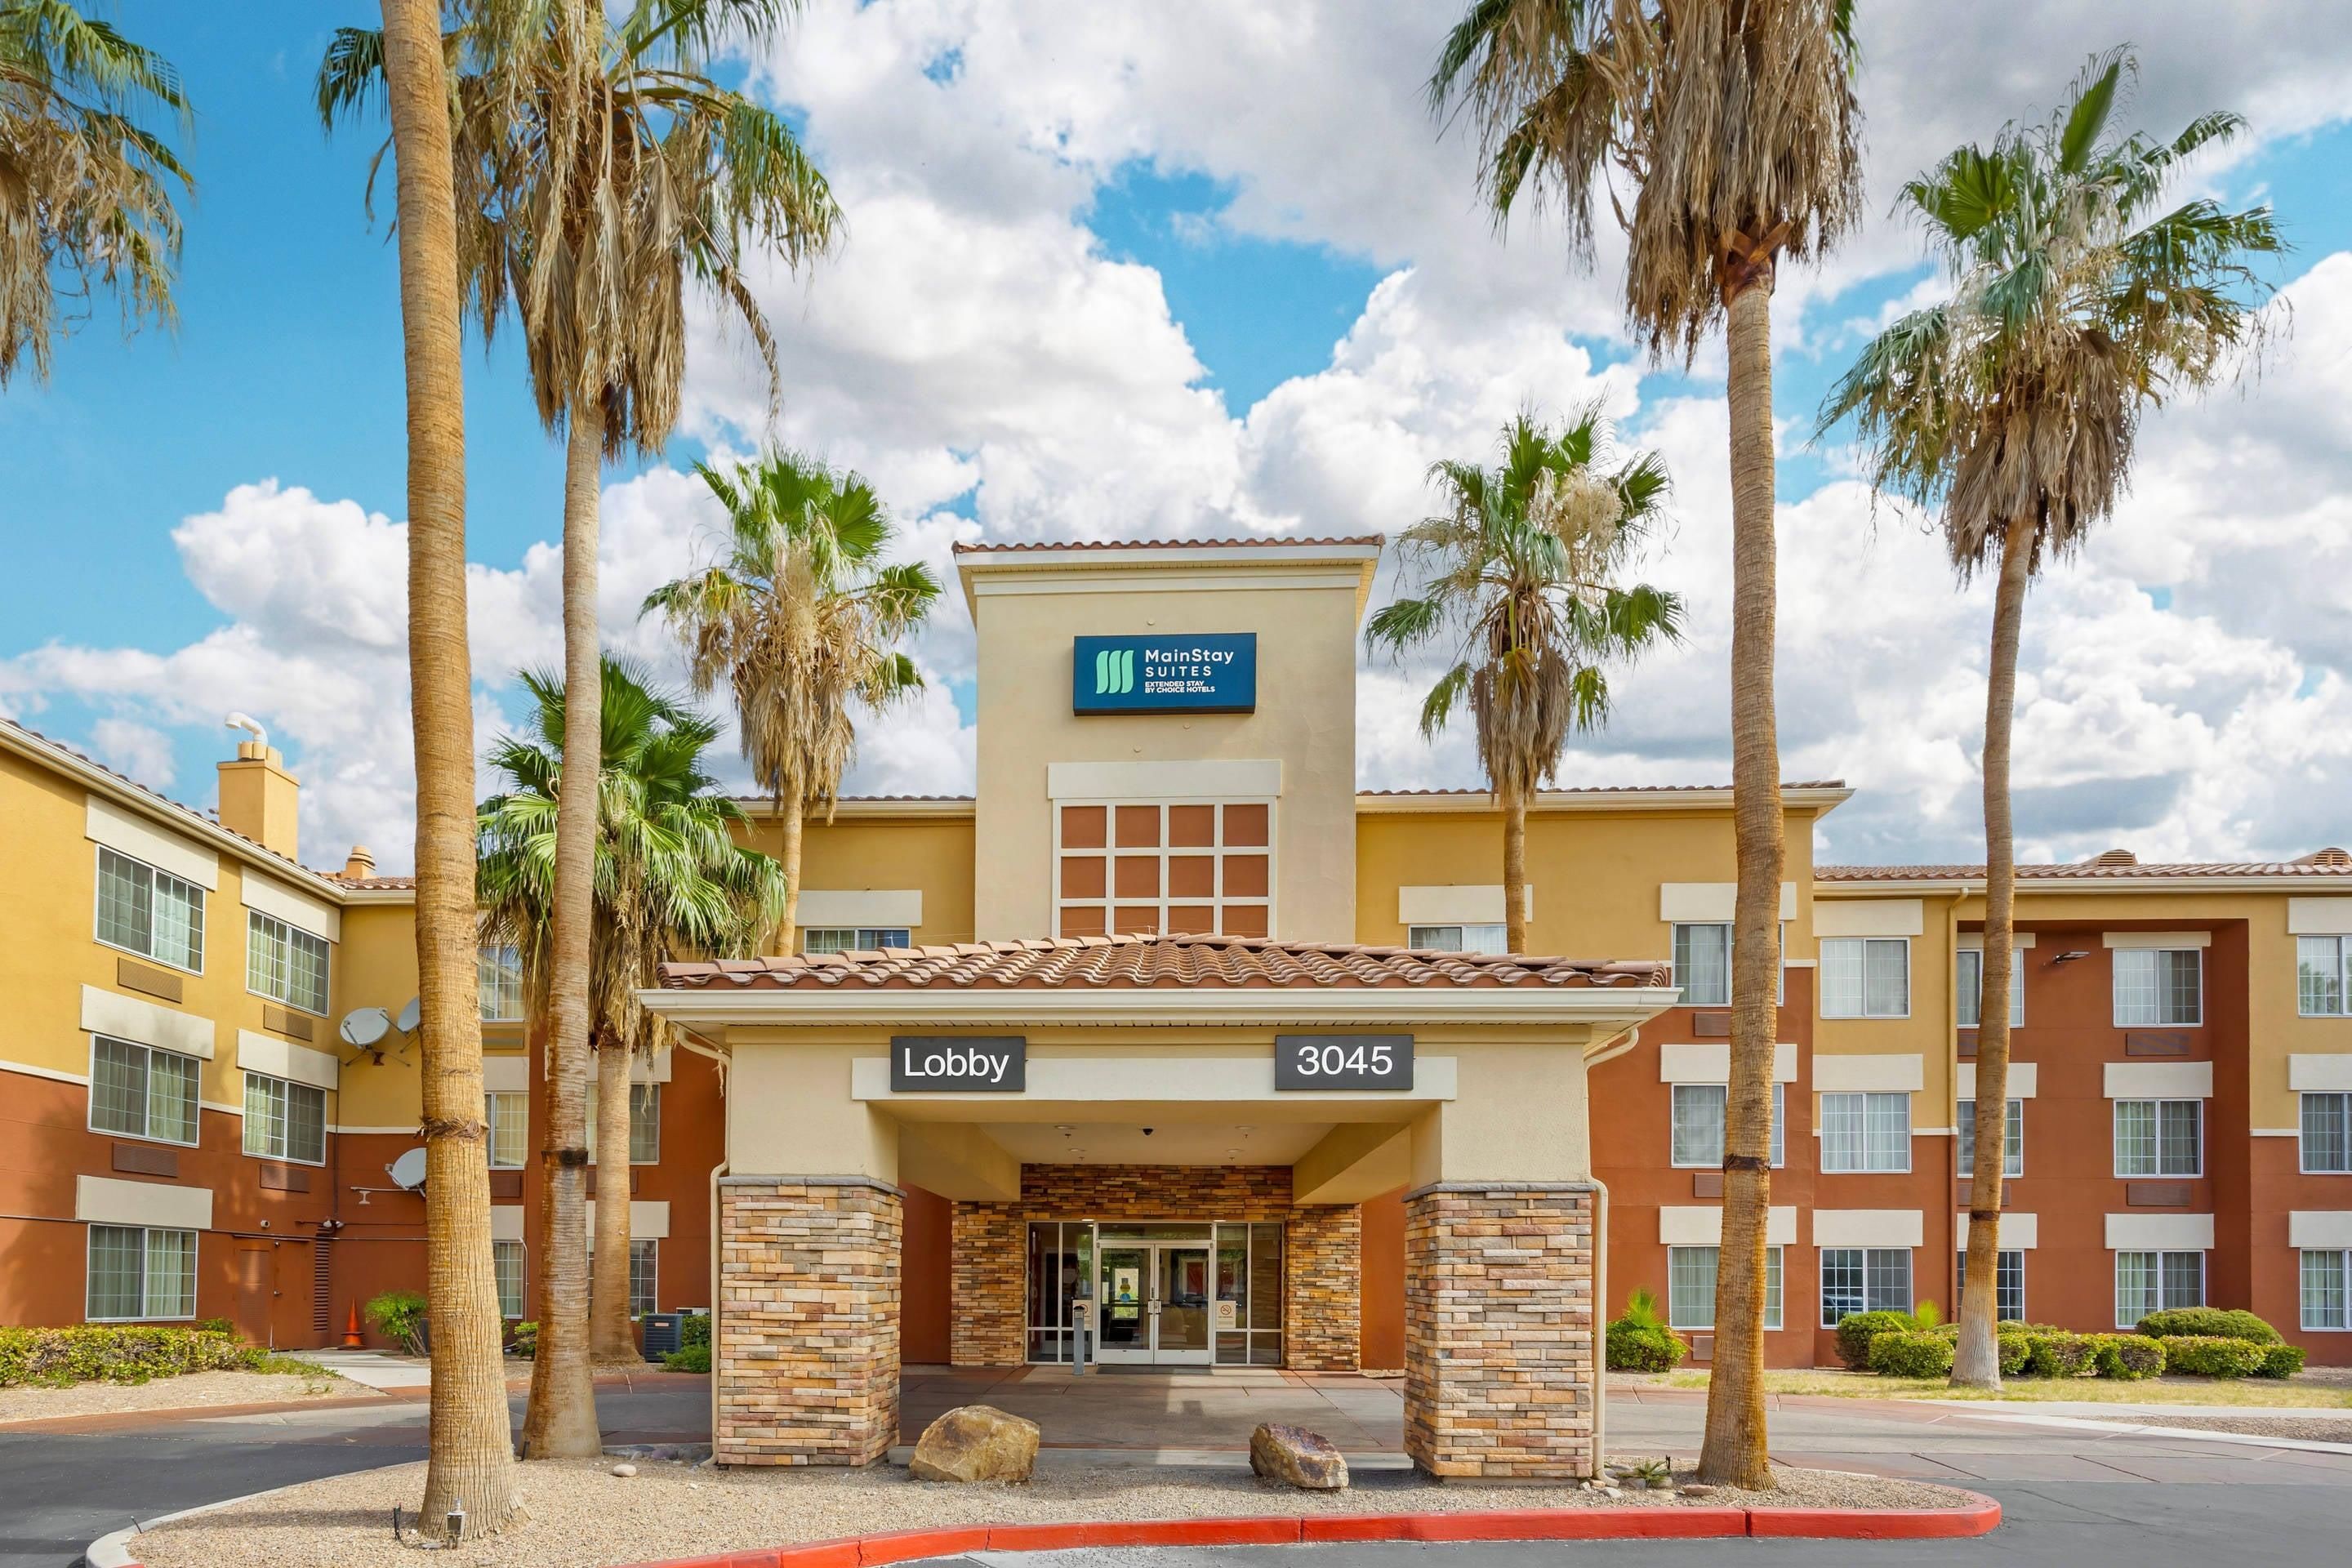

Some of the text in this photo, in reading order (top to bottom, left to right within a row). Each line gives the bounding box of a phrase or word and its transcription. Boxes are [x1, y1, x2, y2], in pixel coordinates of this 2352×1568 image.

[1145, 648, 1234, 665] MainStay
[1145, 666, 1212, 677] SUITES
[905, 1048, 1009, 1083] Lobby
[1297, 1045, 1393, 1076] 3045
